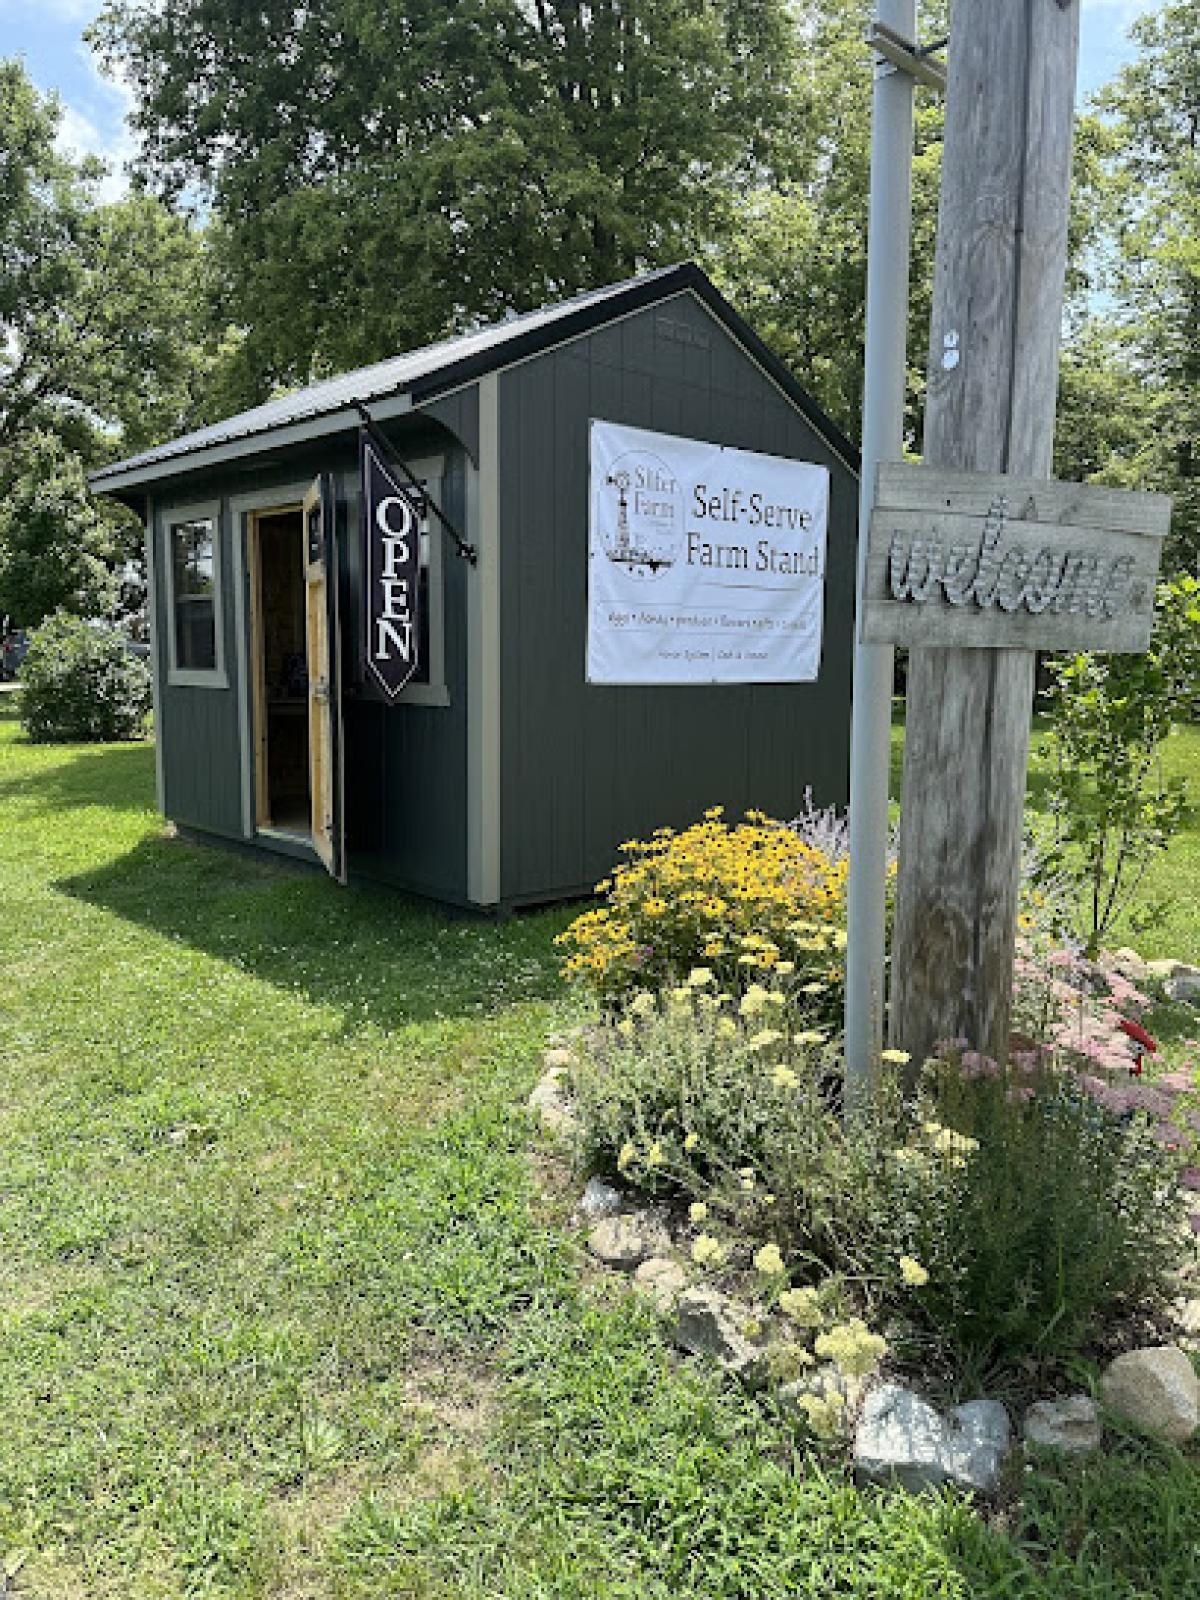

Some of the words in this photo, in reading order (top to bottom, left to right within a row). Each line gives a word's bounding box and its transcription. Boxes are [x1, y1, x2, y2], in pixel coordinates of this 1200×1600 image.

[693, 484, 813, 532] Self-Serve
[686, 532, 749, 569] Farm
[755, 540, 819, 577] Stand
[375, 496, 413, 662] OPEN
